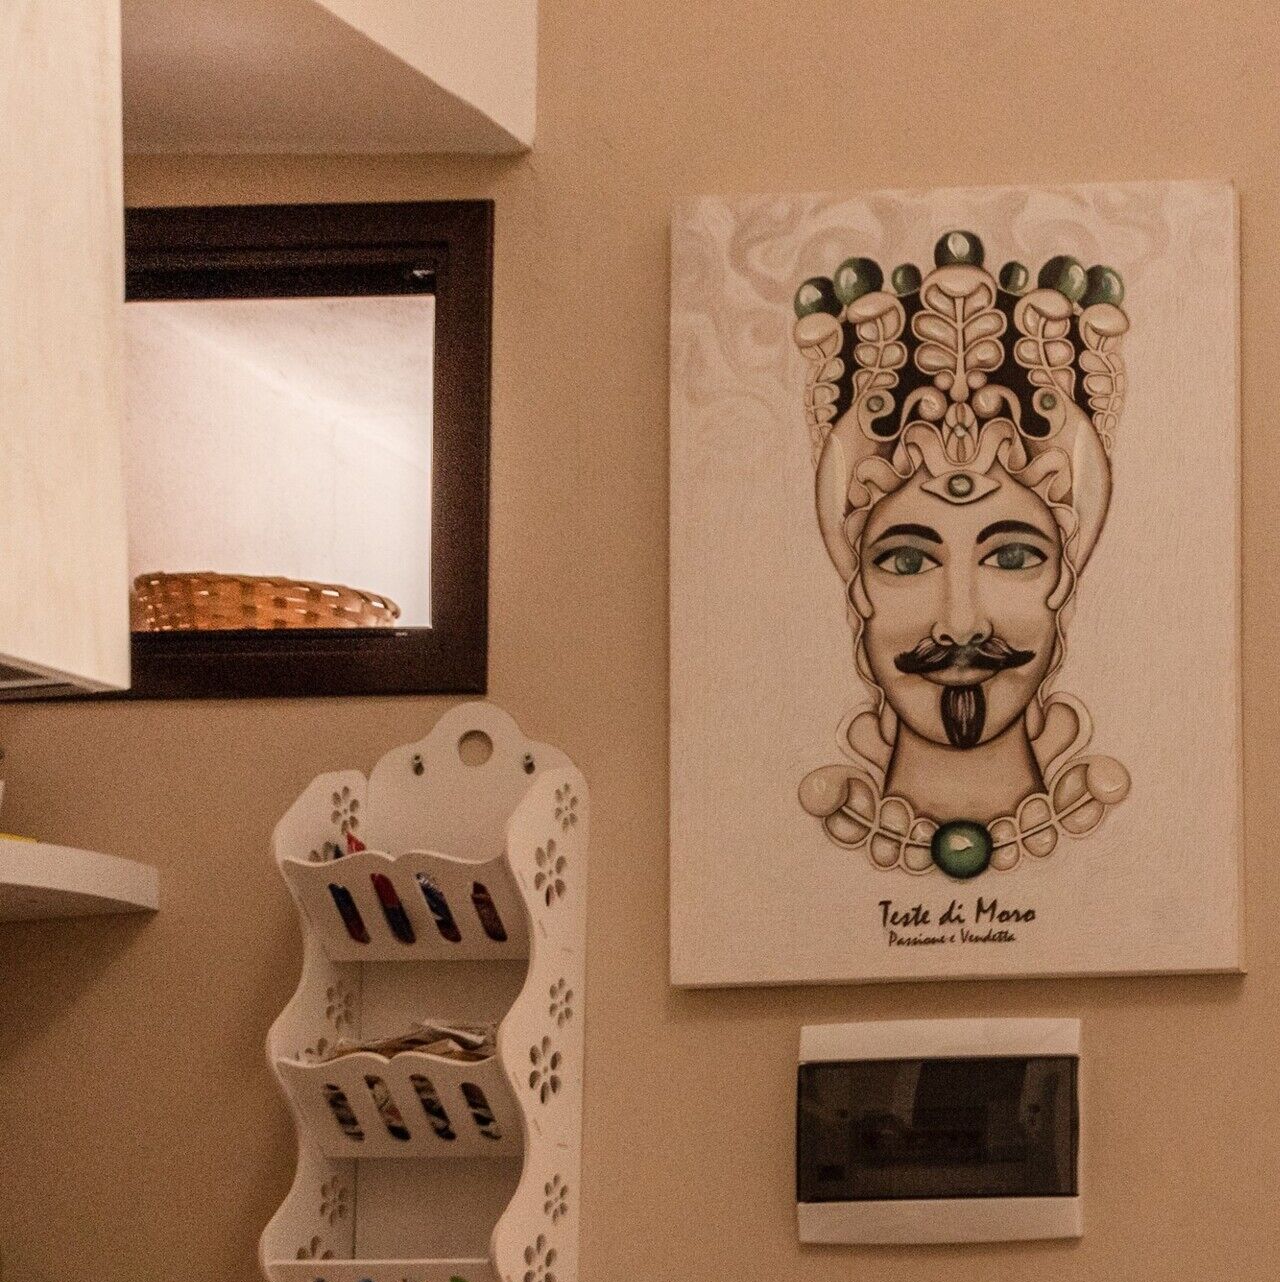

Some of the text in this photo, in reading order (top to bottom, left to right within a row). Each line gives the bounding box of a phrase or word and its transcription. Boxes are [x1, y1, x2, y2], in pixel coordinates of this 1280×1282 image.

[878, 897, 1036, 927] Teste di Moro
[888, 930, 945, 947] Passione
[960, 928, 1016, 944] Vendetta
